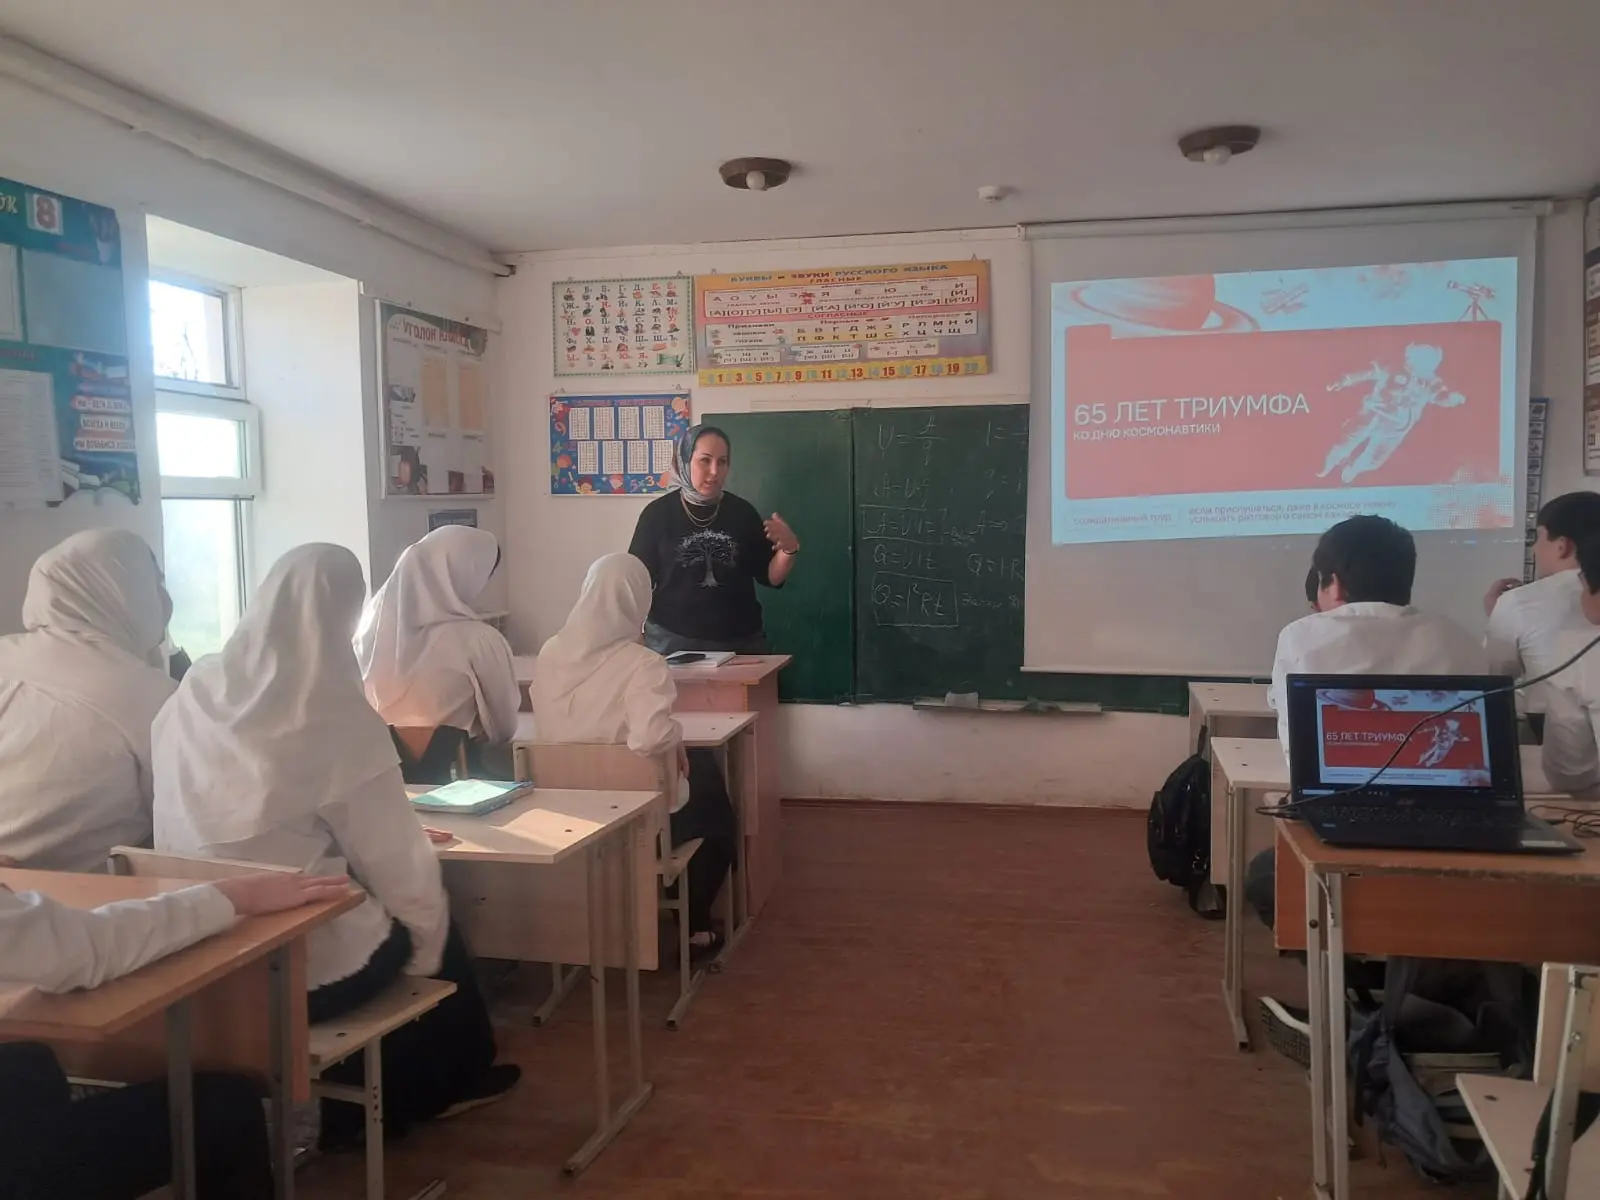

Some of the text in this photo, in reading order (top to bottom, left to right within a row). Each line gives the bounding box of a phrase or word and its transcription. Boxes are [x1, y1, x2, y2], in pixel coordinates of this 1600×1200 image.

[36, 196, 56, 228] 8
[736, 373, 742, 382] 3
[756, 372, 762, 381] 5
[776, 372, 782, 380] 7
[795, 370, 802, 380] 9
[822, 370, 832, 378] 11
[851, 368, 864, 378] 13
[883, 366, 896, 376] 15
[916, 364, 927, 374] 17
[948, 363, 960, 374] 19
[1074, 392, 1310, 427] 65 ЛЕТ ТРИУМФА
[1072, 423, 1220, 442] КО ДНЮ КОСМОНАВТИКИ
[1326, 732, 1413, 742] 65 ЛЕТ ТРИУМФ
